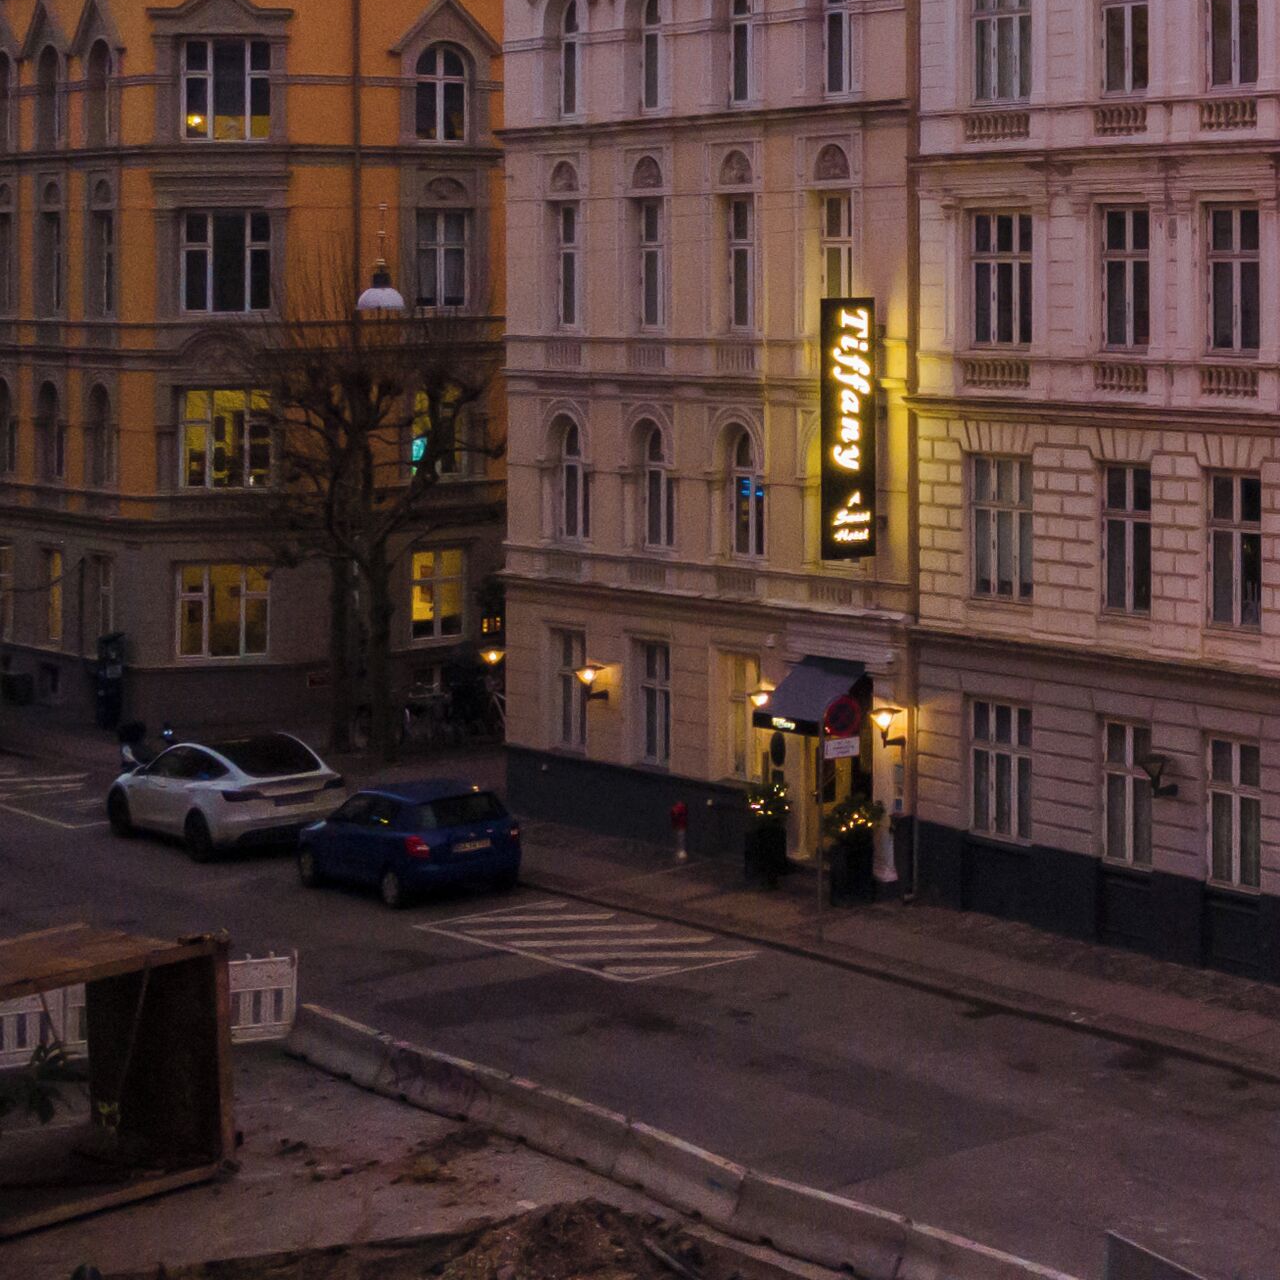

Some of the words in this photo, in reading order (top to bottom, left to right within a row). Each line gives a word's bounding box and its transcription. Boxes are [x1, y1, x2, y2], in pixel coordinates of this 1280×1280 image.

[832, 309, 871, 471] Tiffany
[848, 491, 861, 507] A
[834, 528, 869, 542] Hotel
